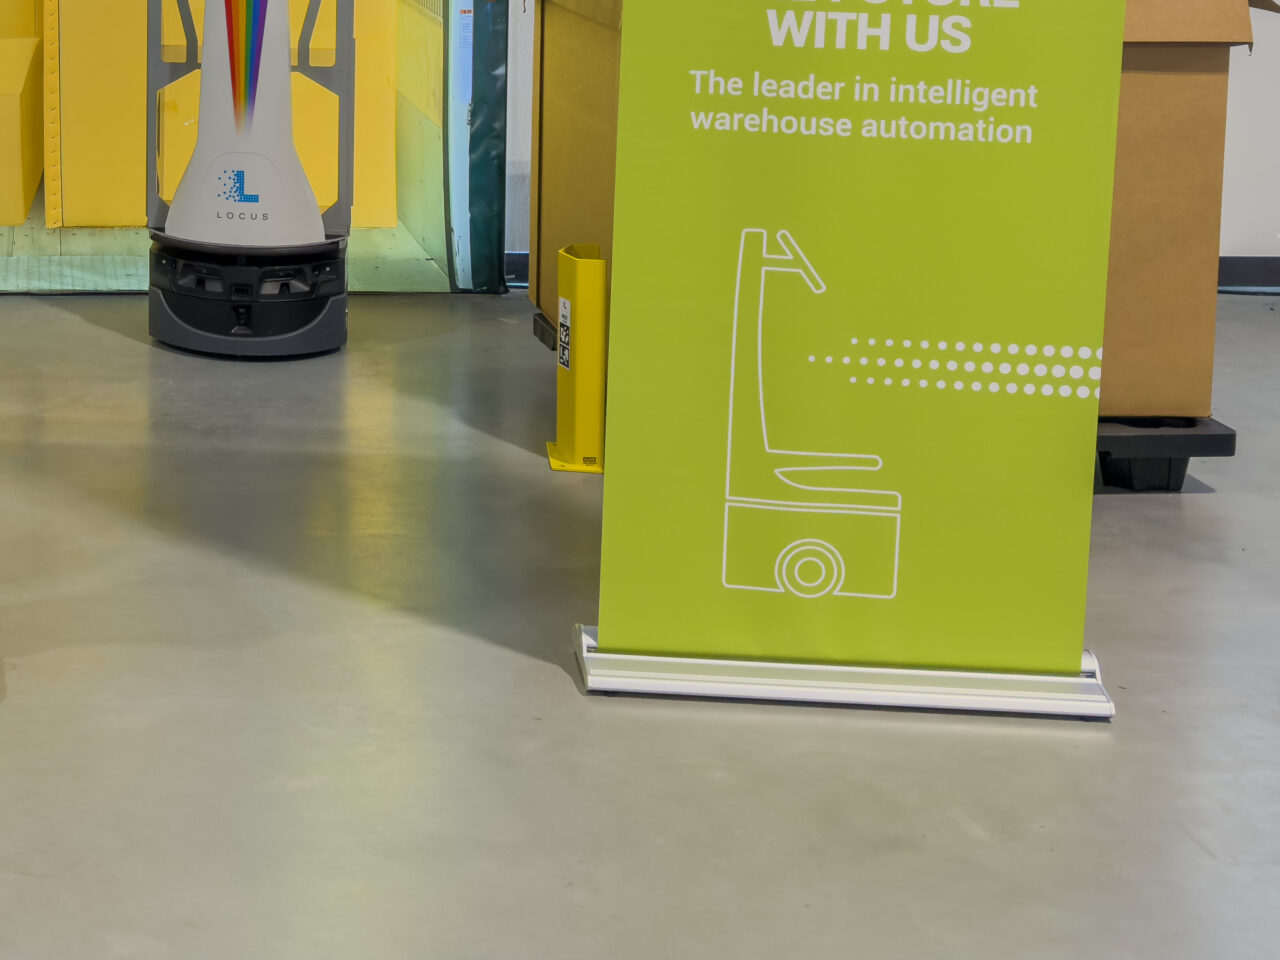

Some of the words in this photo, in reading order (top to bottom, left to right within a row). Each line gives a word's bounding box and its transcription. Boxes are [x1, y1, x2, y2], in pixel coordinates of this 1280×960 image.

[766, 8, 892, 52] WITH
[904, 13, 973, 54] US
[688, 68, 744, 97] The
[753, 70, 846, 101] leader
[853, 74, 880, 103] in
[889, 76, 1039, 113] intelligent
[690, 106, 853, 137] warehouse
[860, 115, 1033, 145] automation
[216, 211, 269, 221] LOCUS
